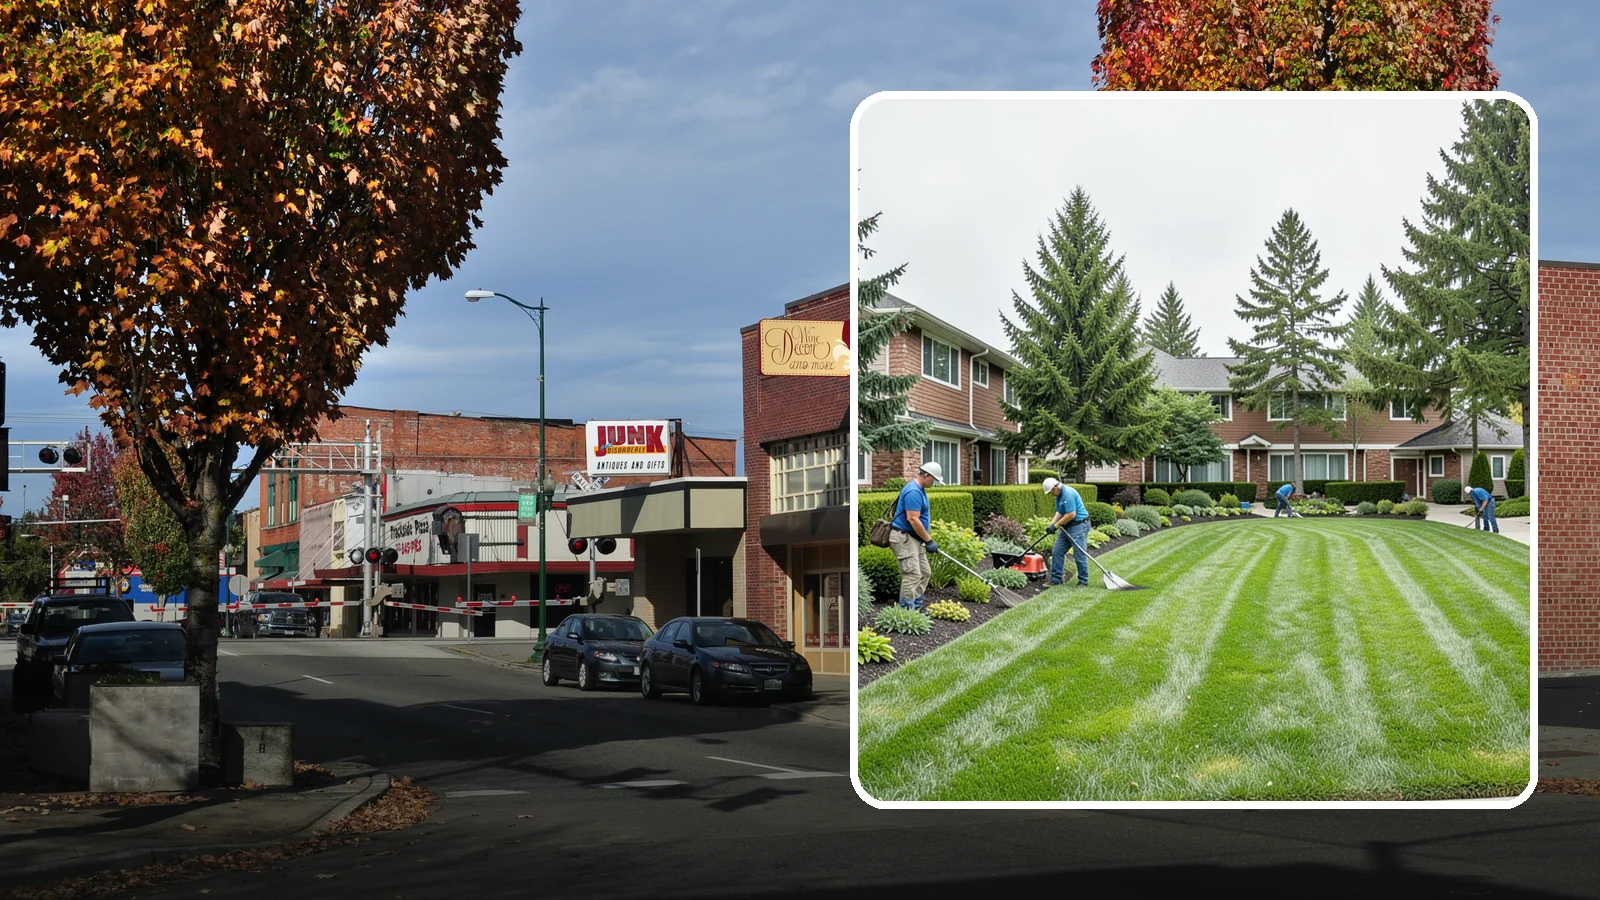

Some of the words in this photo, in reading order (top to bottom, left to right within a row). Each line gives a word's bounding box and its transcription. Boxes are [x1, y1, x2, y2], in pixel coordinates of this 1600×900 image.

[791, 325, 823, 344] Wine
[765, 327, 831, 365] Decor
[595, 425, 665, 457] JUNK
[607, 446, 646, 454] DISORDERLY
[597, 461, 628, 470] ANTIQUES
[631, 461, 643, 470] AND
[647, 460, 665, 470] GIFTS
[390, 522, 413, 540] Trackside
[415, 519, 429, 535] Pizza
